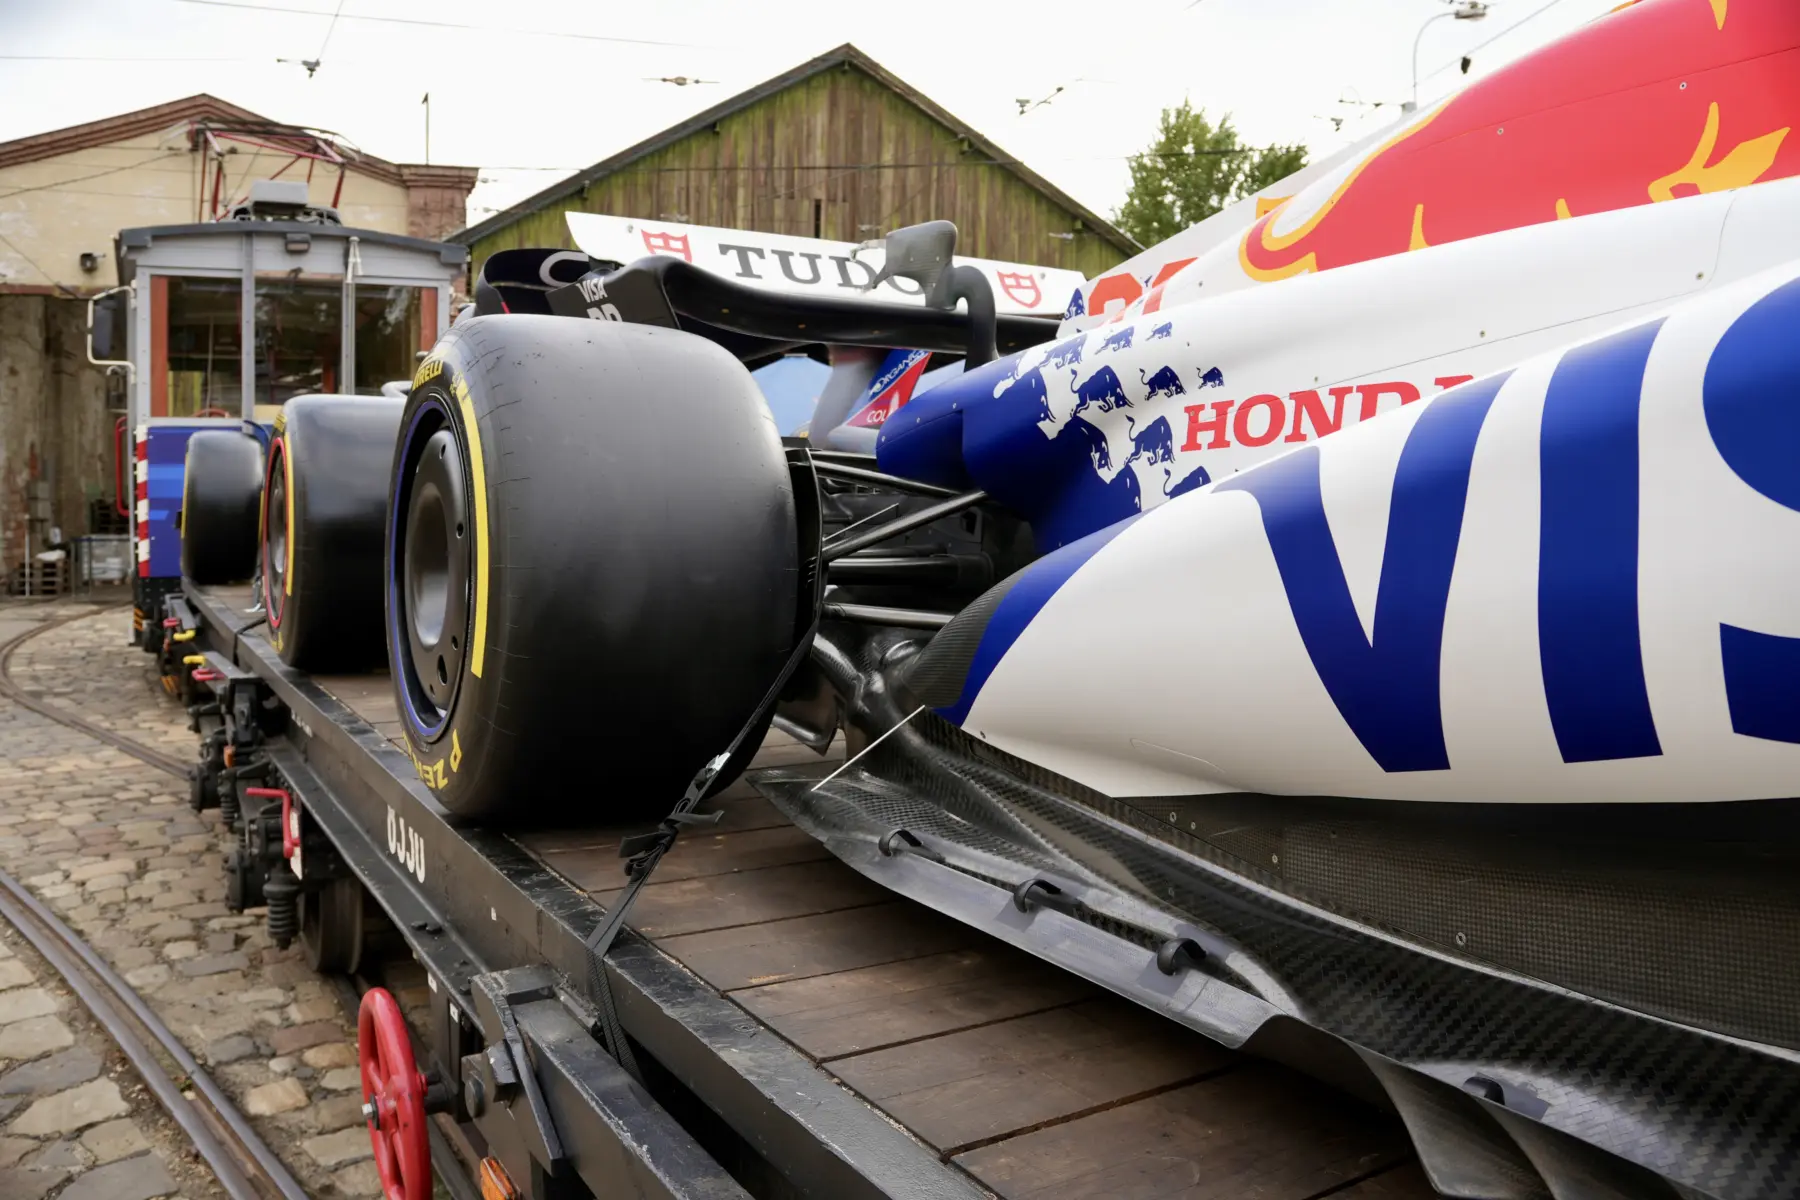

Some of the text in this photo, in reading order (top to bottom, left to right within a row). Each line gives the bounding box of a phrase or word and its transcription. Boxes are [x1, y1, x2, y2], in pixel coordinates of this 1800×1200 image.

[718, 243, 924, 295] TUD
[576, 277, 608, 303] VISA
[866, 410, 887, 423] COL
[1181, 375, 1474, 452] HOND
